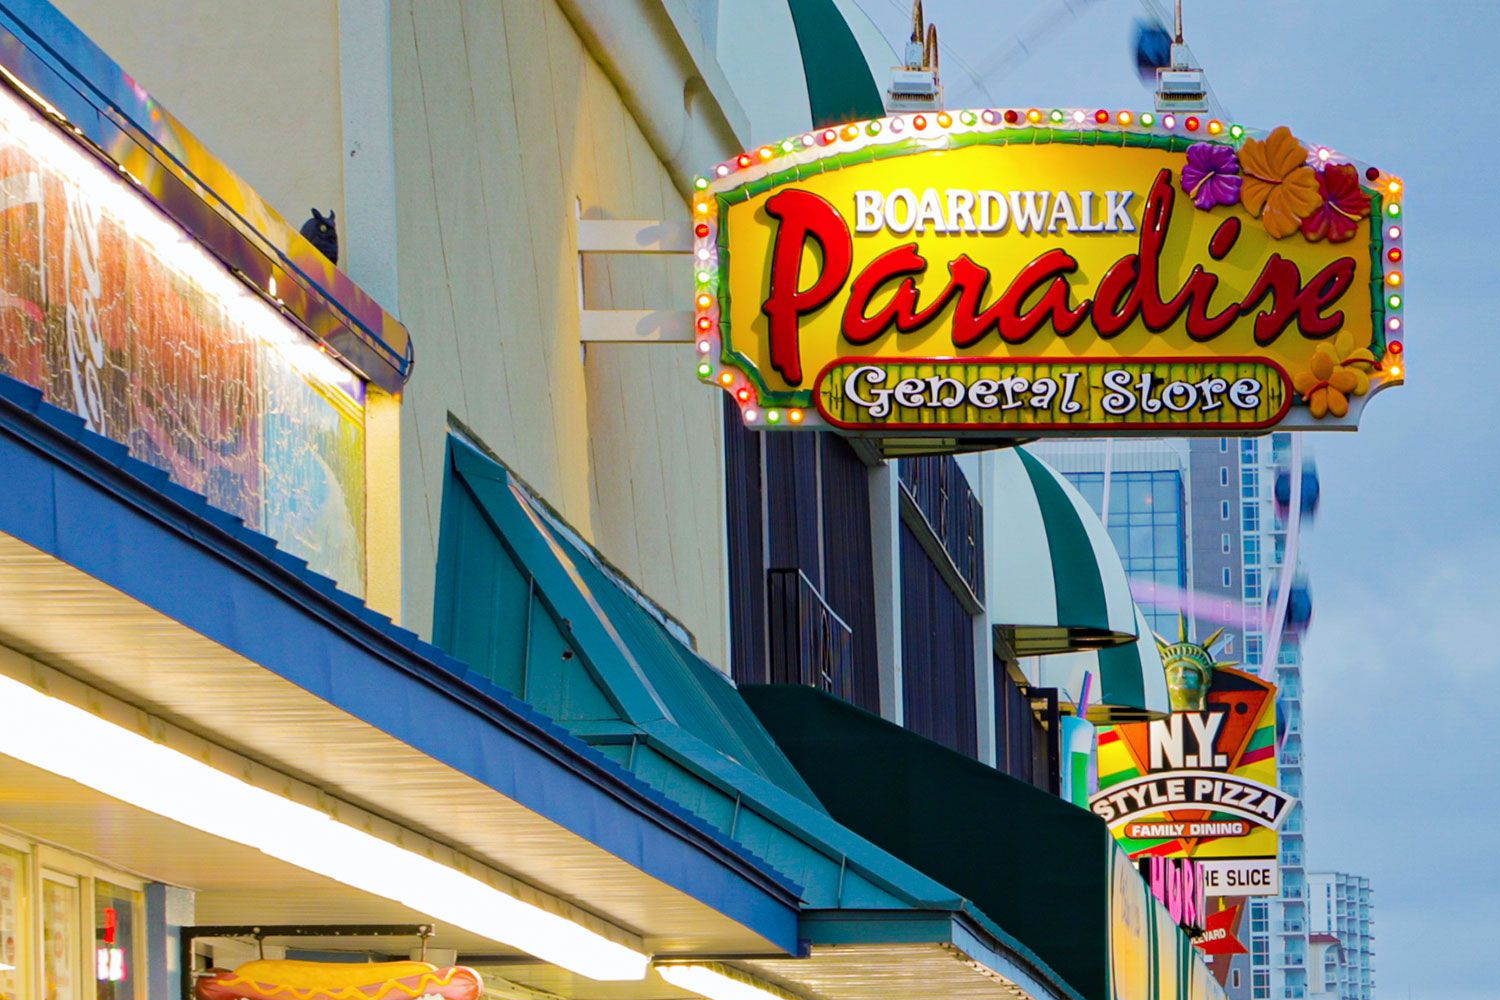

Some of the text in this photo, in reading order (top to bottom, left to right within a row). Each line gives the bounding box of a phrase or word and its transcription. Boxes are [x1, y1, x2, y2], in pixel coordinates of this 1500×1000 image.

[854, 189, 1136, 234] BOARDWALK
[764, 168, 1356, 387] Paradise
[844, 365, 1261, 417] General Store
[1150, 711, 1228, 770] N.Y.
[1092, 778, 1277, 821] STYLE PIZZA
[1131, 822, 1243, 837] FAMILY DINING
[1226, 869, 1271, 886] SLICE
